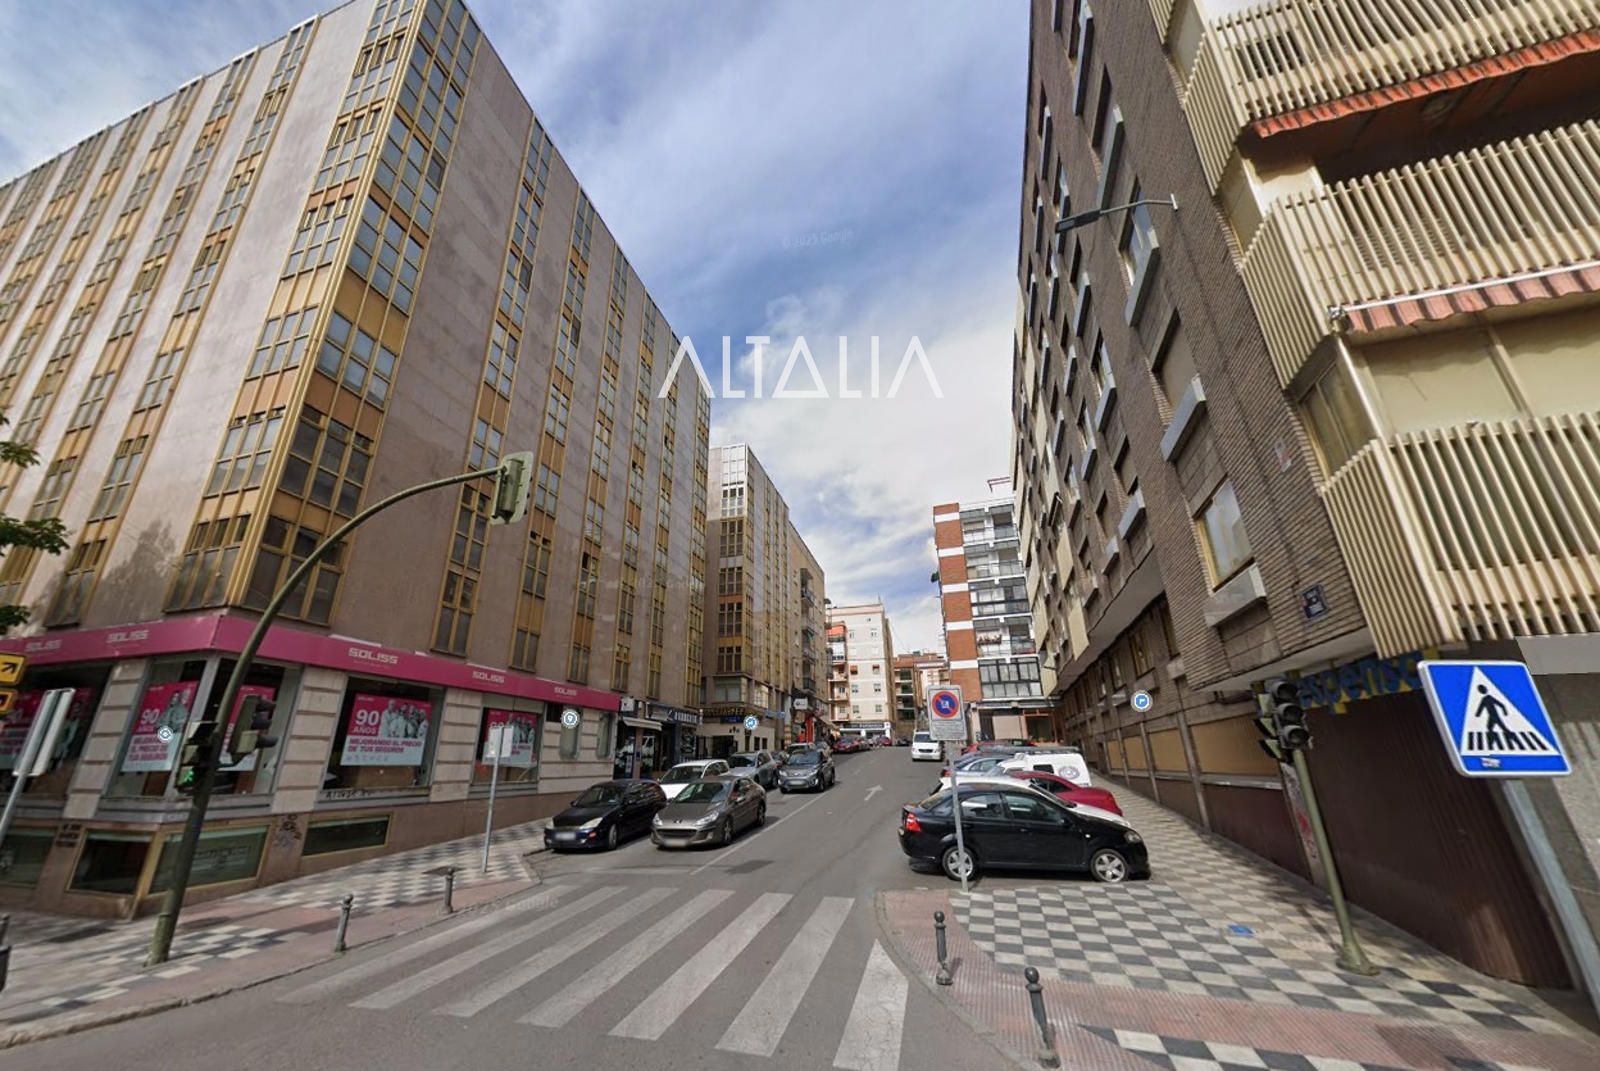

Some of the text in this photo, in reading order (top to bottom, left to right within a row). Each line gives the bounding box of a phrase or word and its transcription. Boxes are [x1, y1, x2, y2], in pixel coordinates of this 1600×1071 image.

[348, 648, 398, 664] SOLISS
[472, 671, 505, 683] SOLISS
[554, 687, 577, 696] SOLISS
[140, 709, 161, 724] 90
[356, 709, 379, 725] 90
[353, 726, 377, 734] AÑOS
